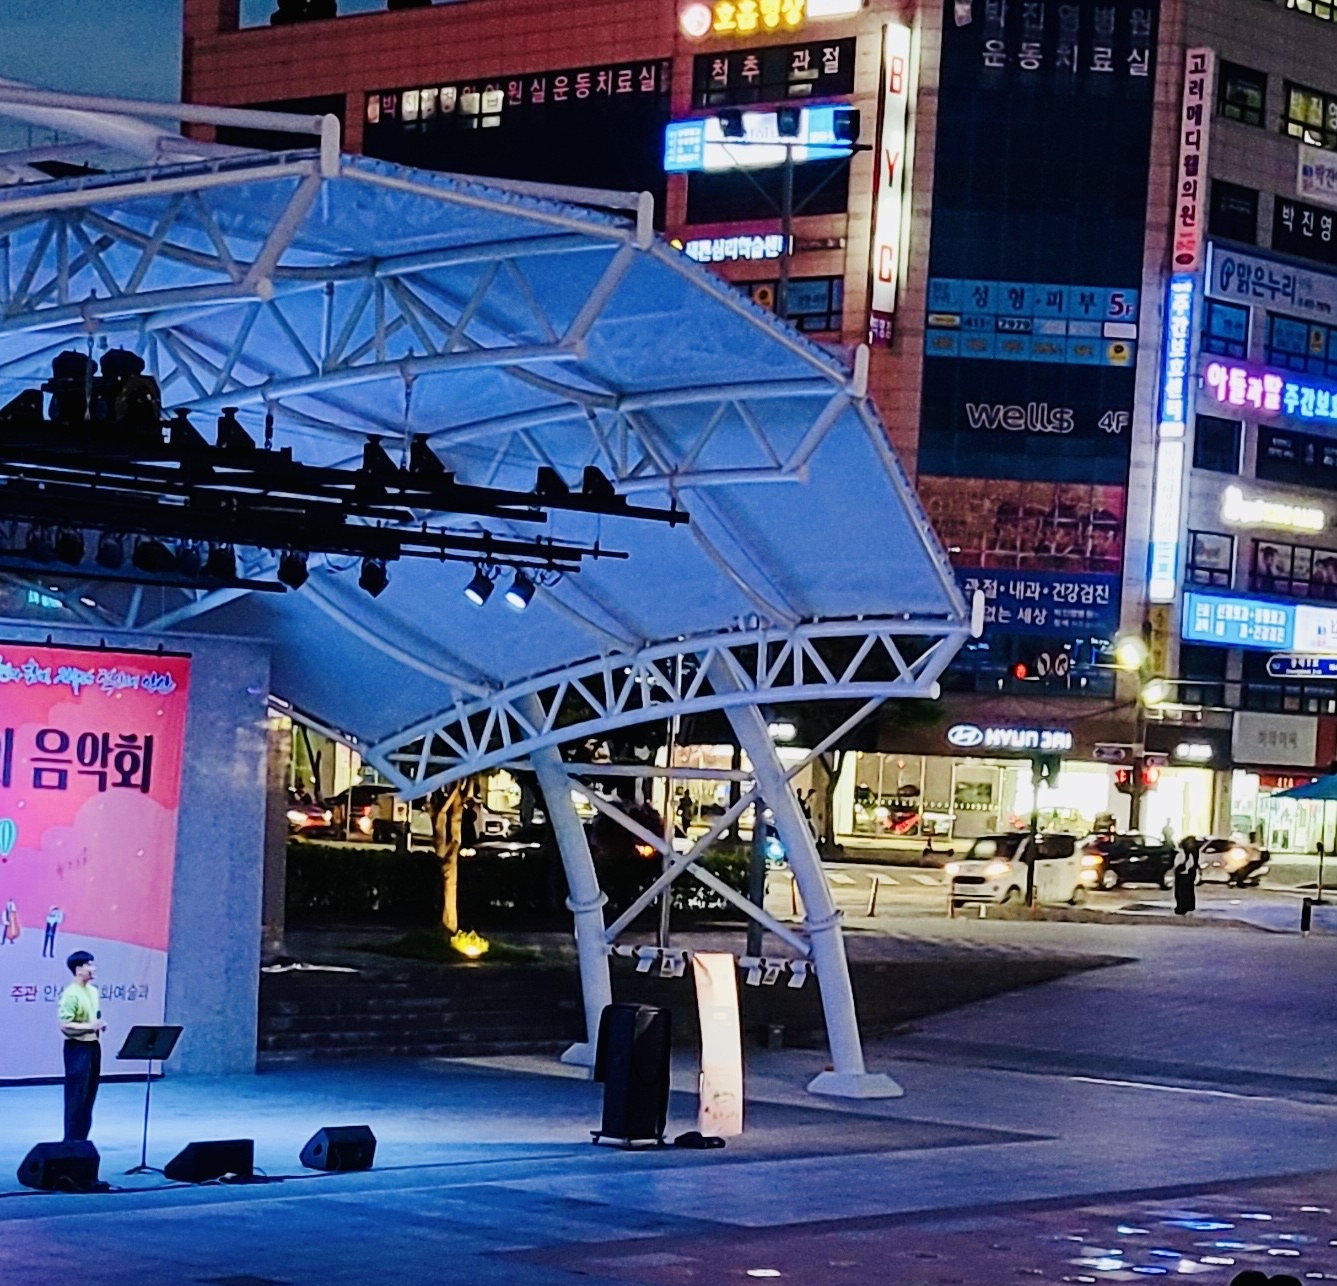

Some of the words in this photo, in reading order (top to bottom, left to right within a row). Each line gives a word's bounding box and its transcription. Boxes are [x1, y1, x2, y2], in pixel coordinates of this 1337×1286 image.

[713, 55, 761, 86] 척추
[792, 46, 840, 76] 관절
[982, 39, 1149, 77] 운동치료실
[552, 66, 656, 101] 운동치료실
[878, 56, 905, 283] BYC
[1237, 263, 1297, 303] 맑은누리
[1109, 293, 1133, 317] 5F
[966, 402, 1075, 433] wells
[1098, 410, 1130, 434] 4F
[1017, 605, 1048, 626] 세상
[984, 727, 1073, 751] HYUNDAI
[30, 728, 155, 795] 음악회
[10, 984, 39, 1003] 주관
